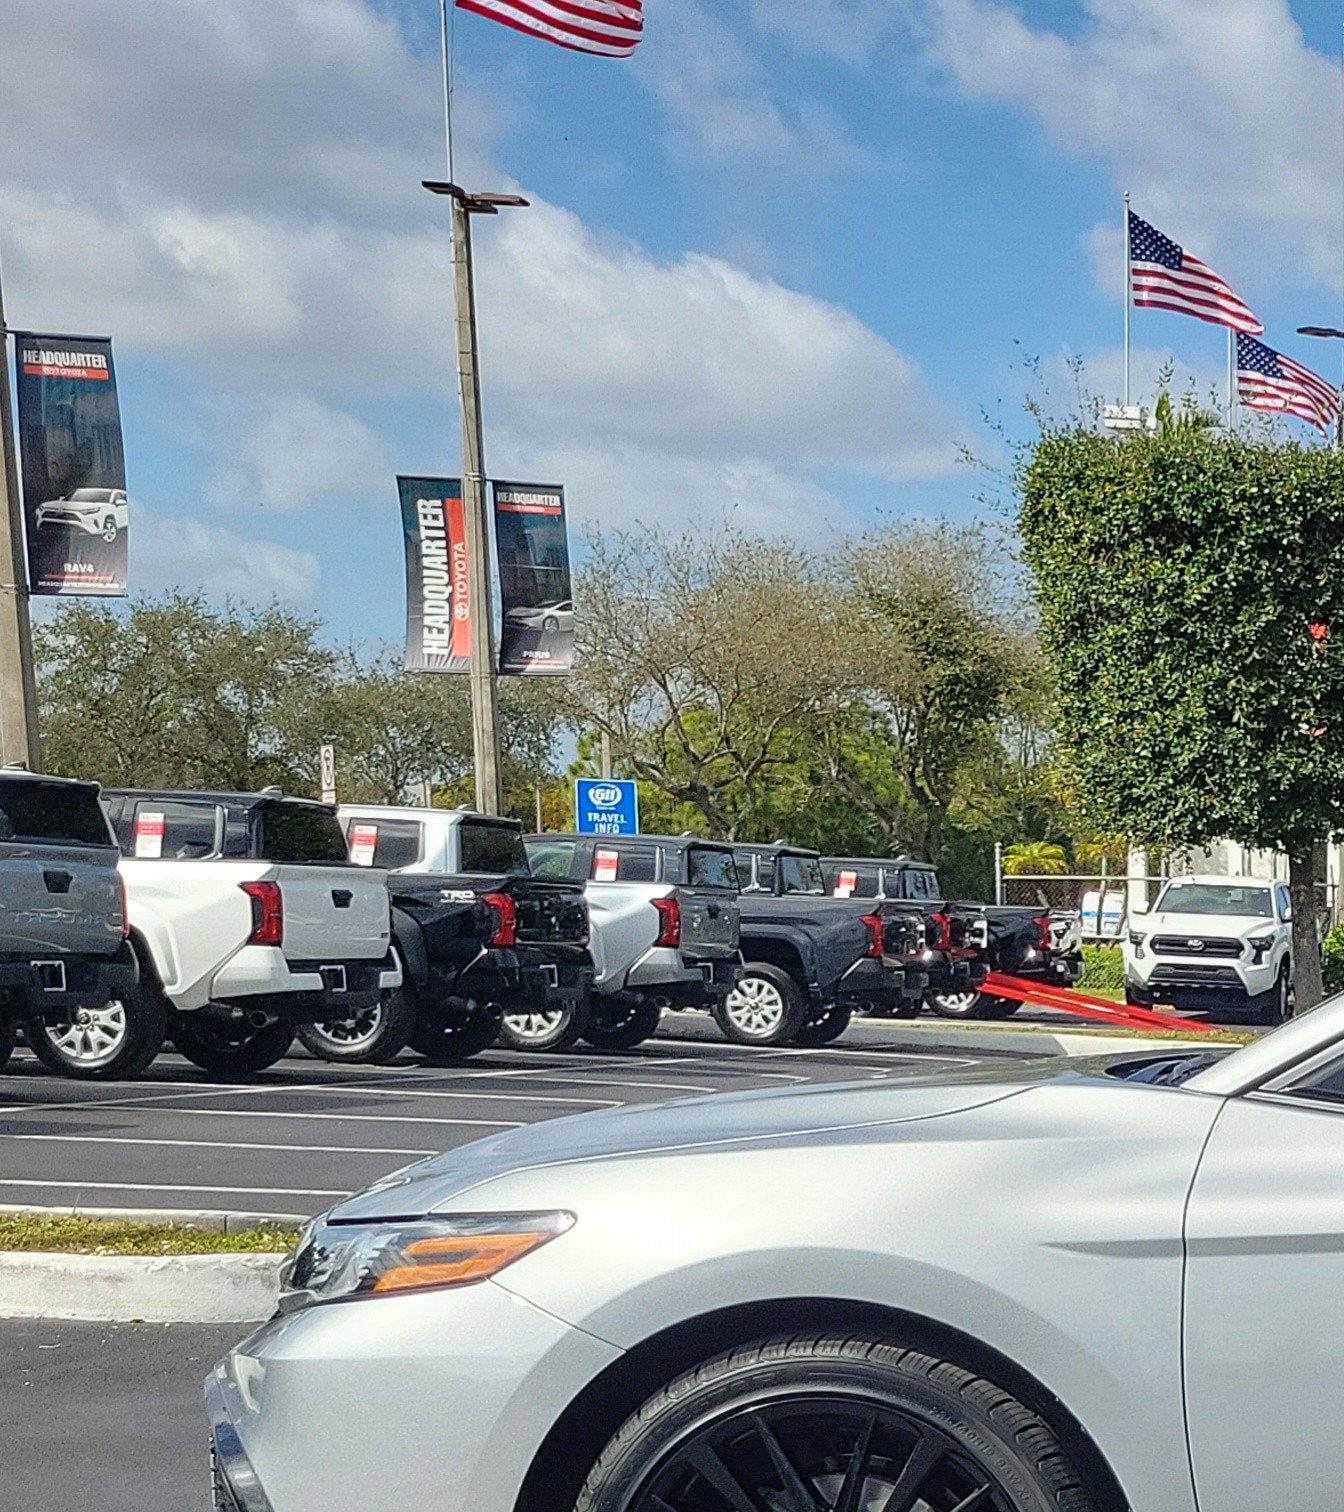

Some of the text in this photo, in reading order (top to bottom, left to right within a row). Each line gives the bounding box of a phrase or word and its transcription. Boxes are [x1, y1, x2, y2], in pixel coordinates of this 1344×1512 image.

[23, 349, 107, 369] HEADQUARTER
[497, 491, 561, 506] HEADQUARTER
[63, 562, 95, 573] RAV4
[452, 541, 471, 600] TOYOTA
[416, 498, 454, 656] HEADQUARTER
[587, 812, 628, 825] TRAVEL
[594, 822, 620, 834] INFO
[440, 890, 476, 900] TRD
